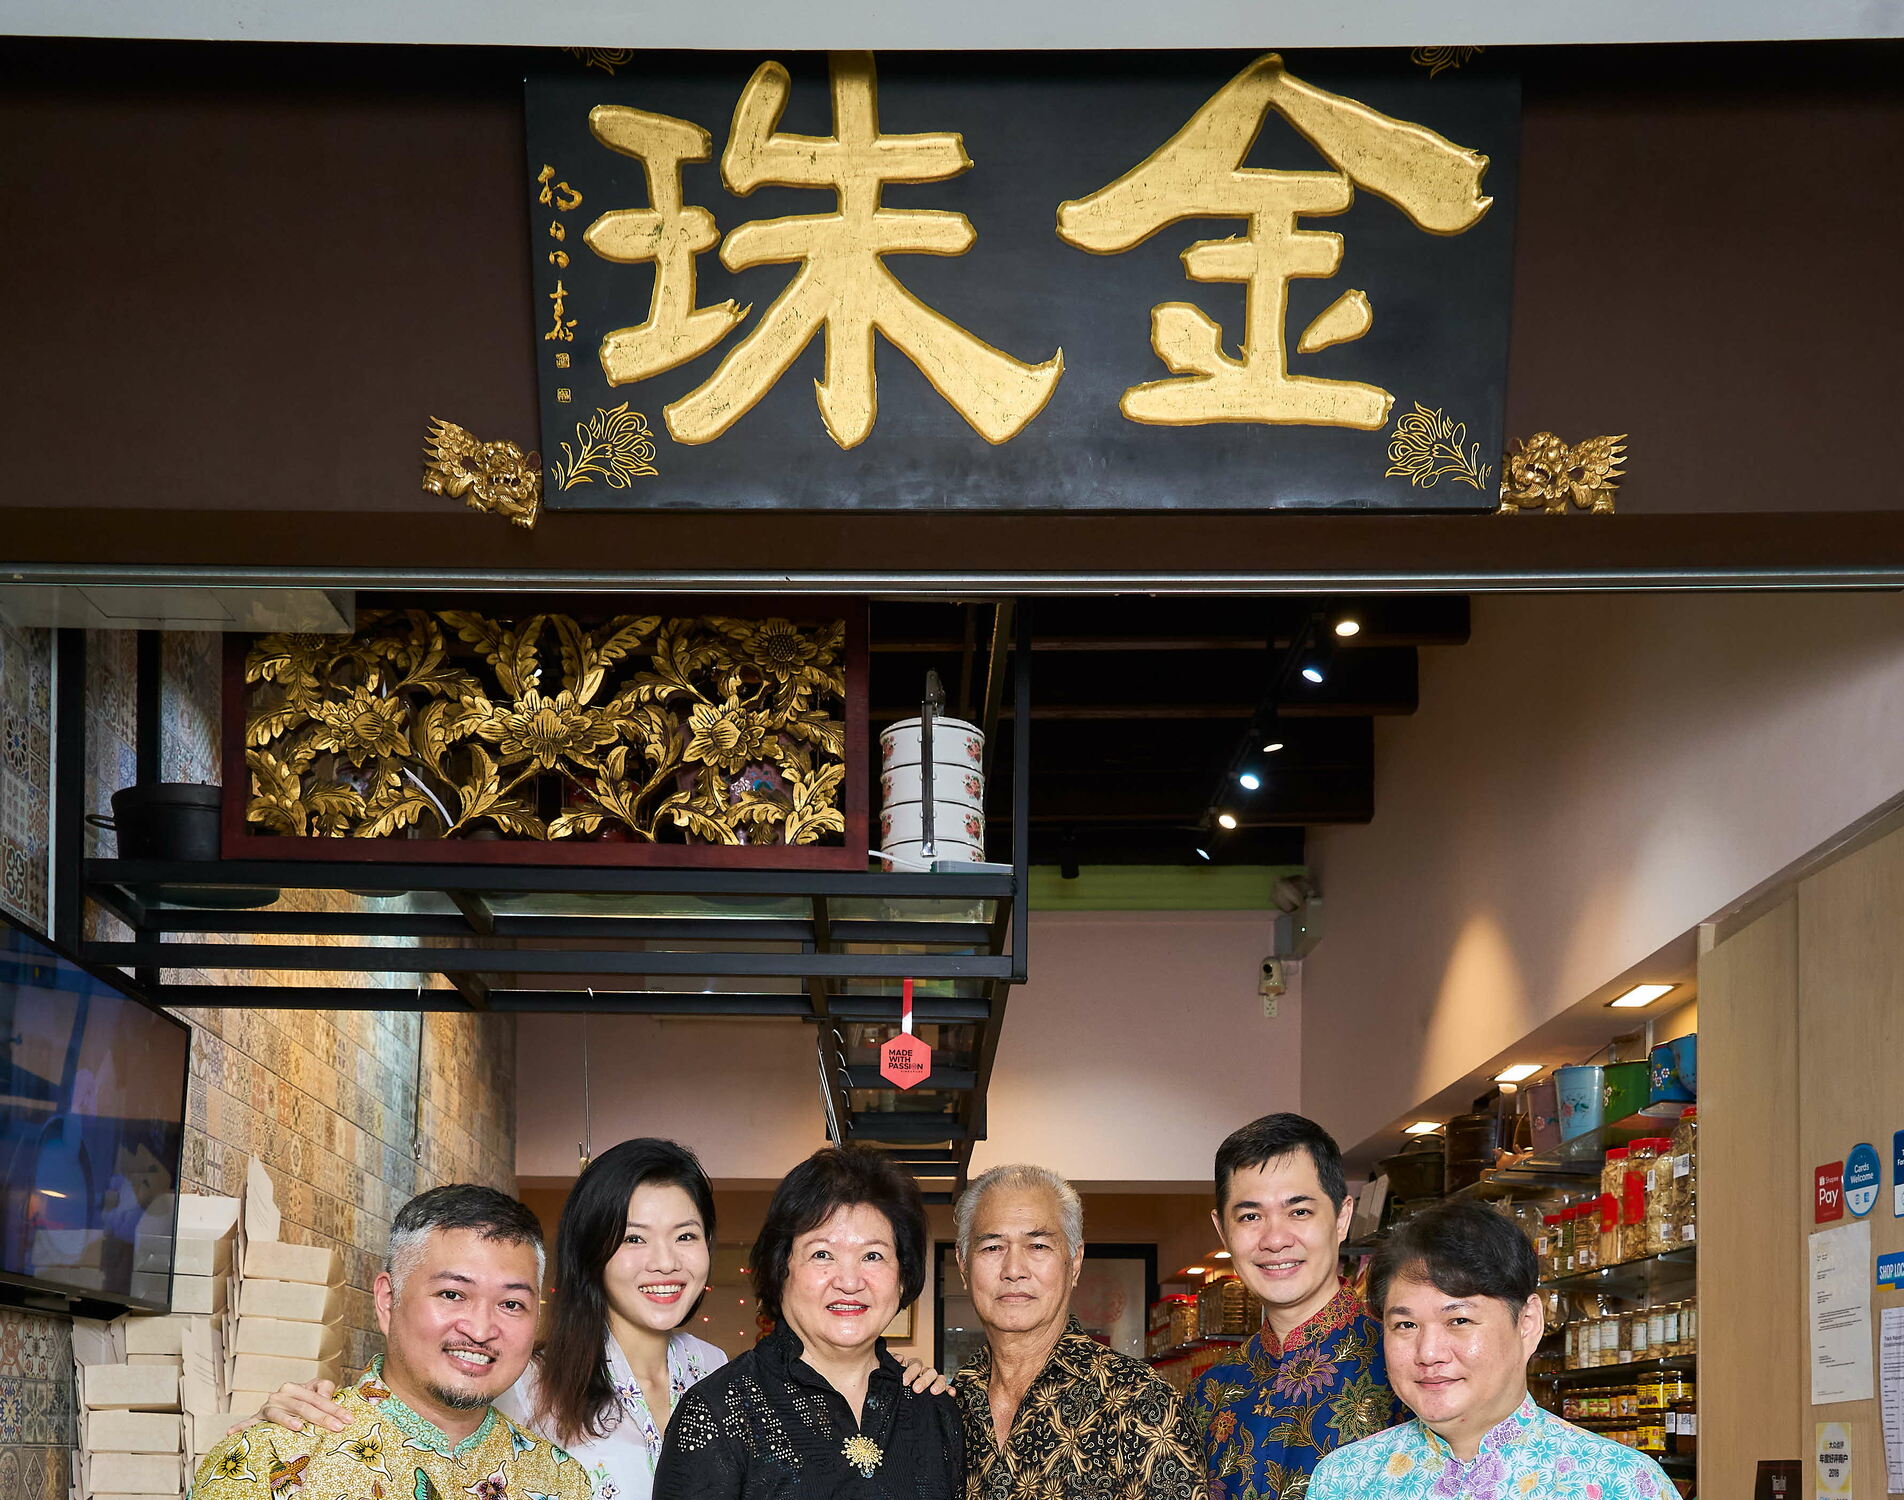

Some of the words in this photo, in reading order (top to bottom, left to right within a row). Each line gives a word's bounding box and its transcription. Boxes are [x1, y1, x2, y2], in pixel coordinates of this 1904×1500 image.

[1854, 1163, 1870, 1173] Cards
[1850, 1172, 1873, 1184] Welcome
[1819, 1188, 1838, 1207] Pay
[1879, 1264, 1894, 1280] SHOP
